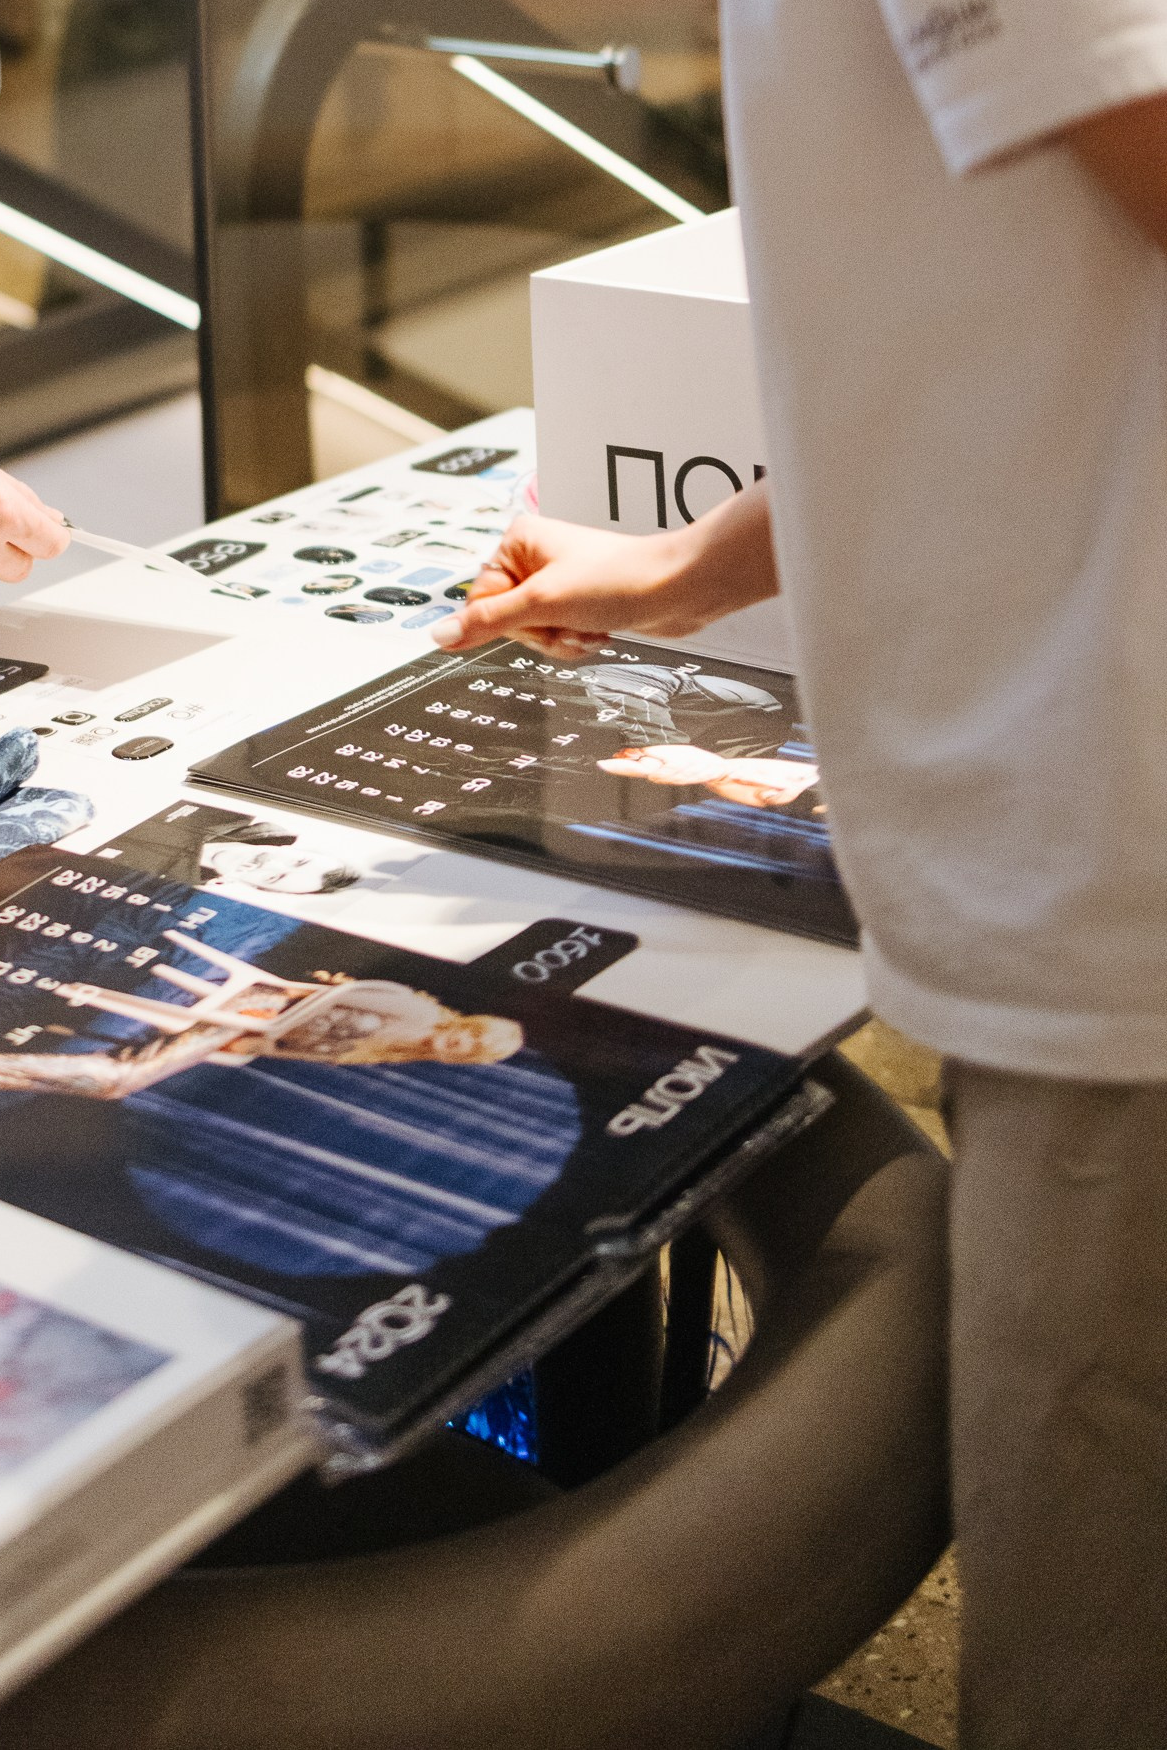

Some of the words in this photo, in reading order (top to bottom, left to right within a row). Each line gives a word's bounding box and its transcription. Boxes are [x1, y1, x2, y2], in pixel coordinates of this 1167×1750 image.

[606, 445, 767, 530] ПО
[184, 543, 247, 572] 850
[508, 657, 534, 670] 24
[620, 653, 639, 662] 2
[535, 663, 555, 674] 17
[555, 669, 578, 680] 10
[468, 679, 493, 692] 25
[580, 675, 599, 684] 3
[492, 686, 514, 697] 18
[516, 692, 536, 702] 11
[425, 701, 451, 714] 26
[540, 698, 557, 707] 4
[449, 708, 472, 719] 19
[471, 714, 495, 726] 12
[384, 723, 407, 737] 27
[497, 721, 517, 730] 5
[404, 729, 431, 742] 20
[429, 736, 452, 748] 13
[551, 733, 580, 747] ЧТ
[335, 743, 363, 757] 28
[359, 751, 384, 762] 21
[383, 758, 407, 769] 14
[509, 754, 538, 770] ПТ
[286, 765, 314, 779] 29
[411, 765, 430, 775] 7
[308, 771, 338, 785] 22
[334, 779, 359, 791] 15
[360, 787, 382, 797] 8
[460, 778, 492, 793] СБ
[385, 794, 403, 803] 1
[412, 800, 447, 816] ВС
[49, 869, 82, 887] 29
[72, 876, 107, 894] 22
[99, 885, 128, 900] 15
[150, 903, 172, 913] 1
[15, 912, 50, 932] 23
[177, 906, 218, 930] ПН
[41, 922, 72, 938] 16
[68, 931, 94, 944] 9
[92, 938, 119, 952] 2
[124, 946, 161, 969] ВТ
[512, 926, 602, 984] 1600
[6, 967, 39, 985] 10
[34, 977, 61, 991] 3
[3, 1024, 44, 1046] ЧТ
[605, 1044, 741, 1138] ИЮЛЬ
[316, 1283, 451, 1379] 2024
